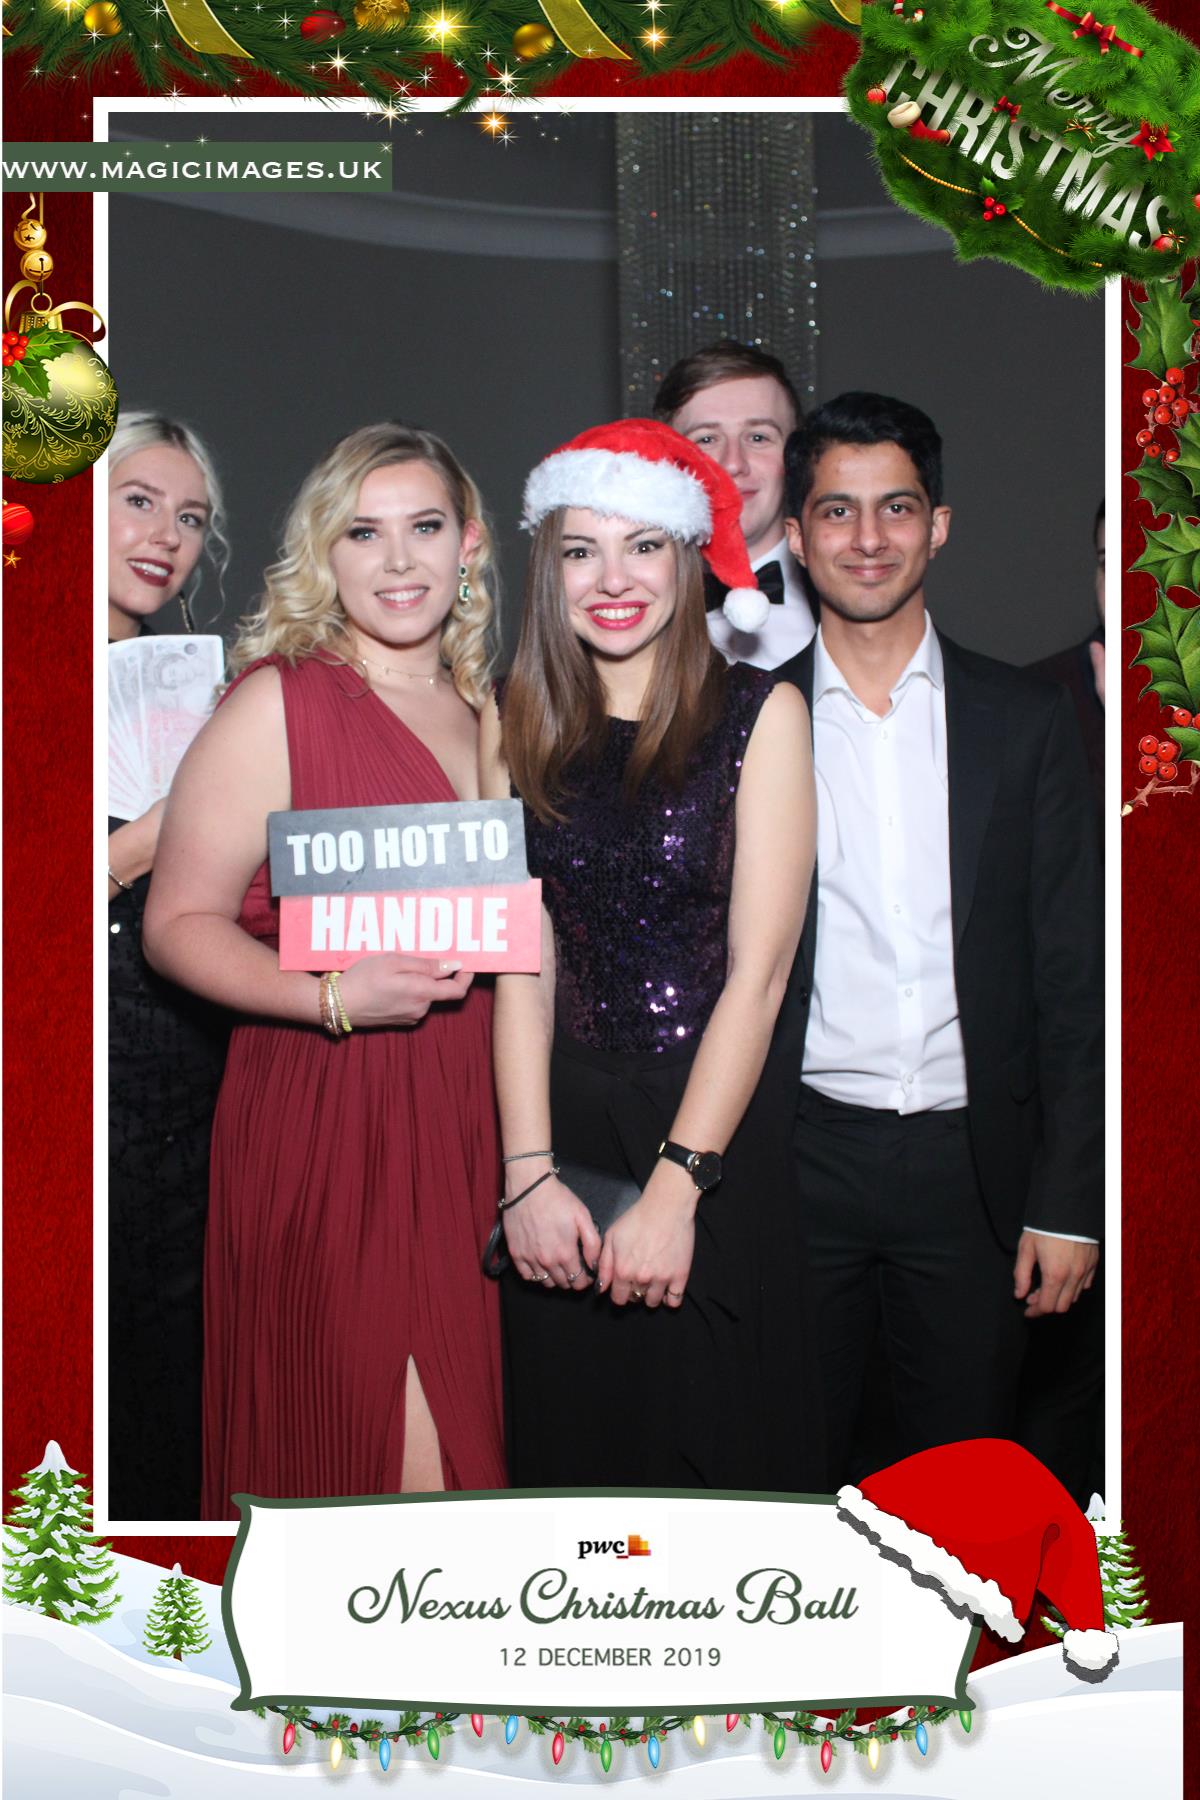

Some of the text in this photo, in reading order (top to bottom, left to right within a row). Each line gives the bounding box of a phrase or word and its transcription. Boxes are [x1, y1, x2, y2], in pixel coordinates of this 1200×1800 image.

[286, 819, 509, 876] TOO HOT TO
[310, 896, 508, 952] HANDLE
